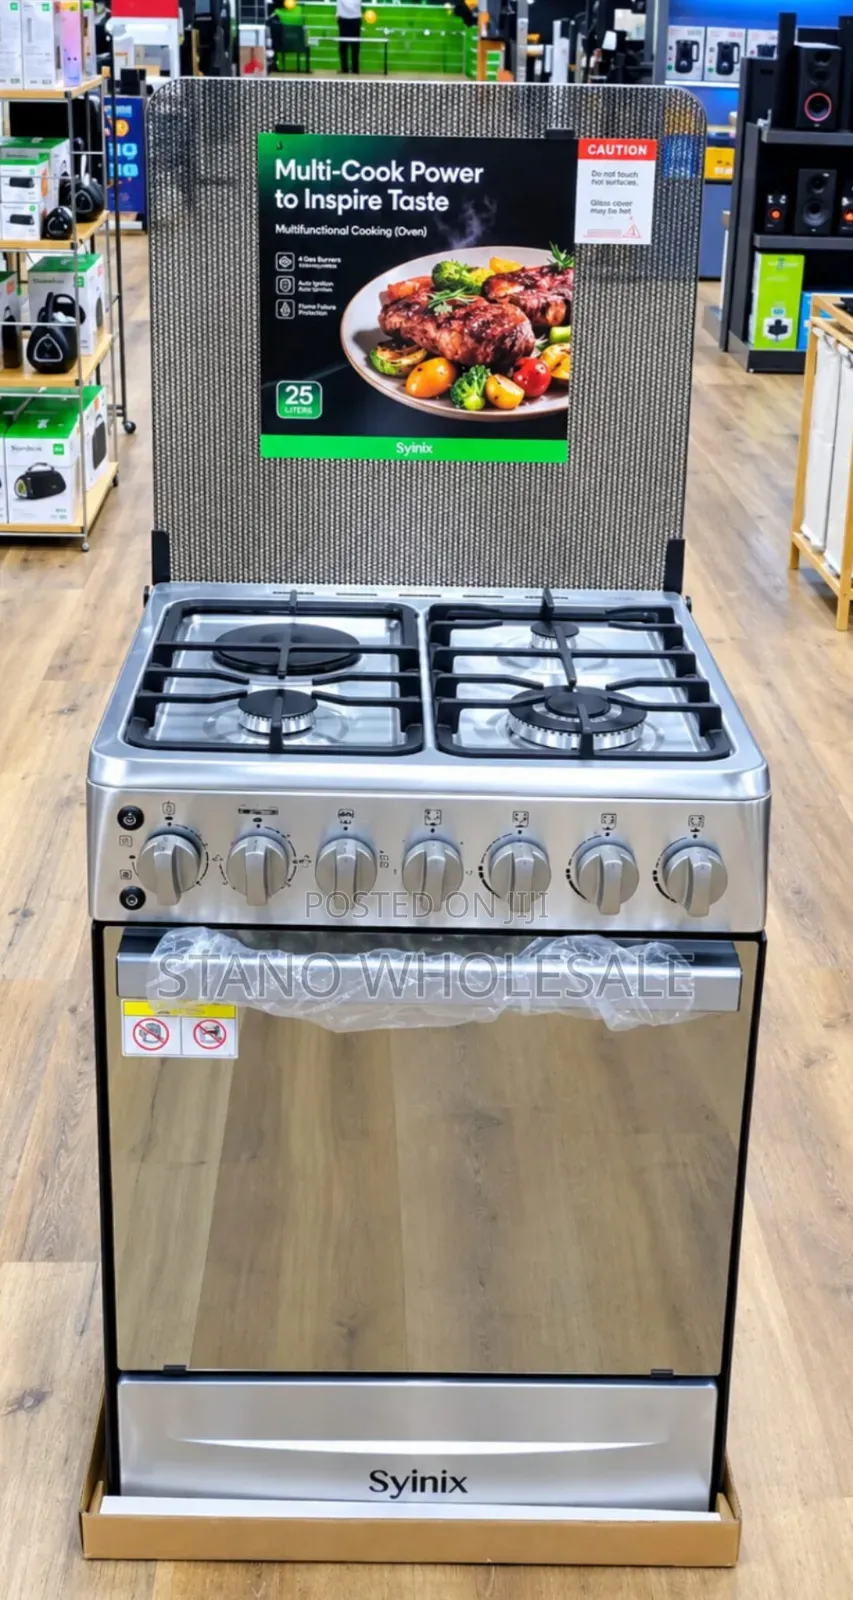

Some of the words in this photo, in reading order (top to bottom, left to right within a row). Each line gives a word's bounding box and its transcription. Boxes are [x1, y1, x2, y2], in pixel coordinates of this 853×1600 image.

[587, 144, 648, 155] CAUTION
[275, 158, 405, 182] Multi-Cook
[410, 161, 484, 184] Power
[275, 189, 298, 209] to
[304, 188, 383, 215] Inspire
[387, 188, 450, 212] Taste
[275, 224, 349, 235] Multifunctional
[351, 225, 392, 238] Cooking
[394, 226, 427, 238] (Oven)
[285, 385, 314, 405] 25
[396, 442, 433, 456] Syinix
[369, 1469, 468, 1499] Syinix
